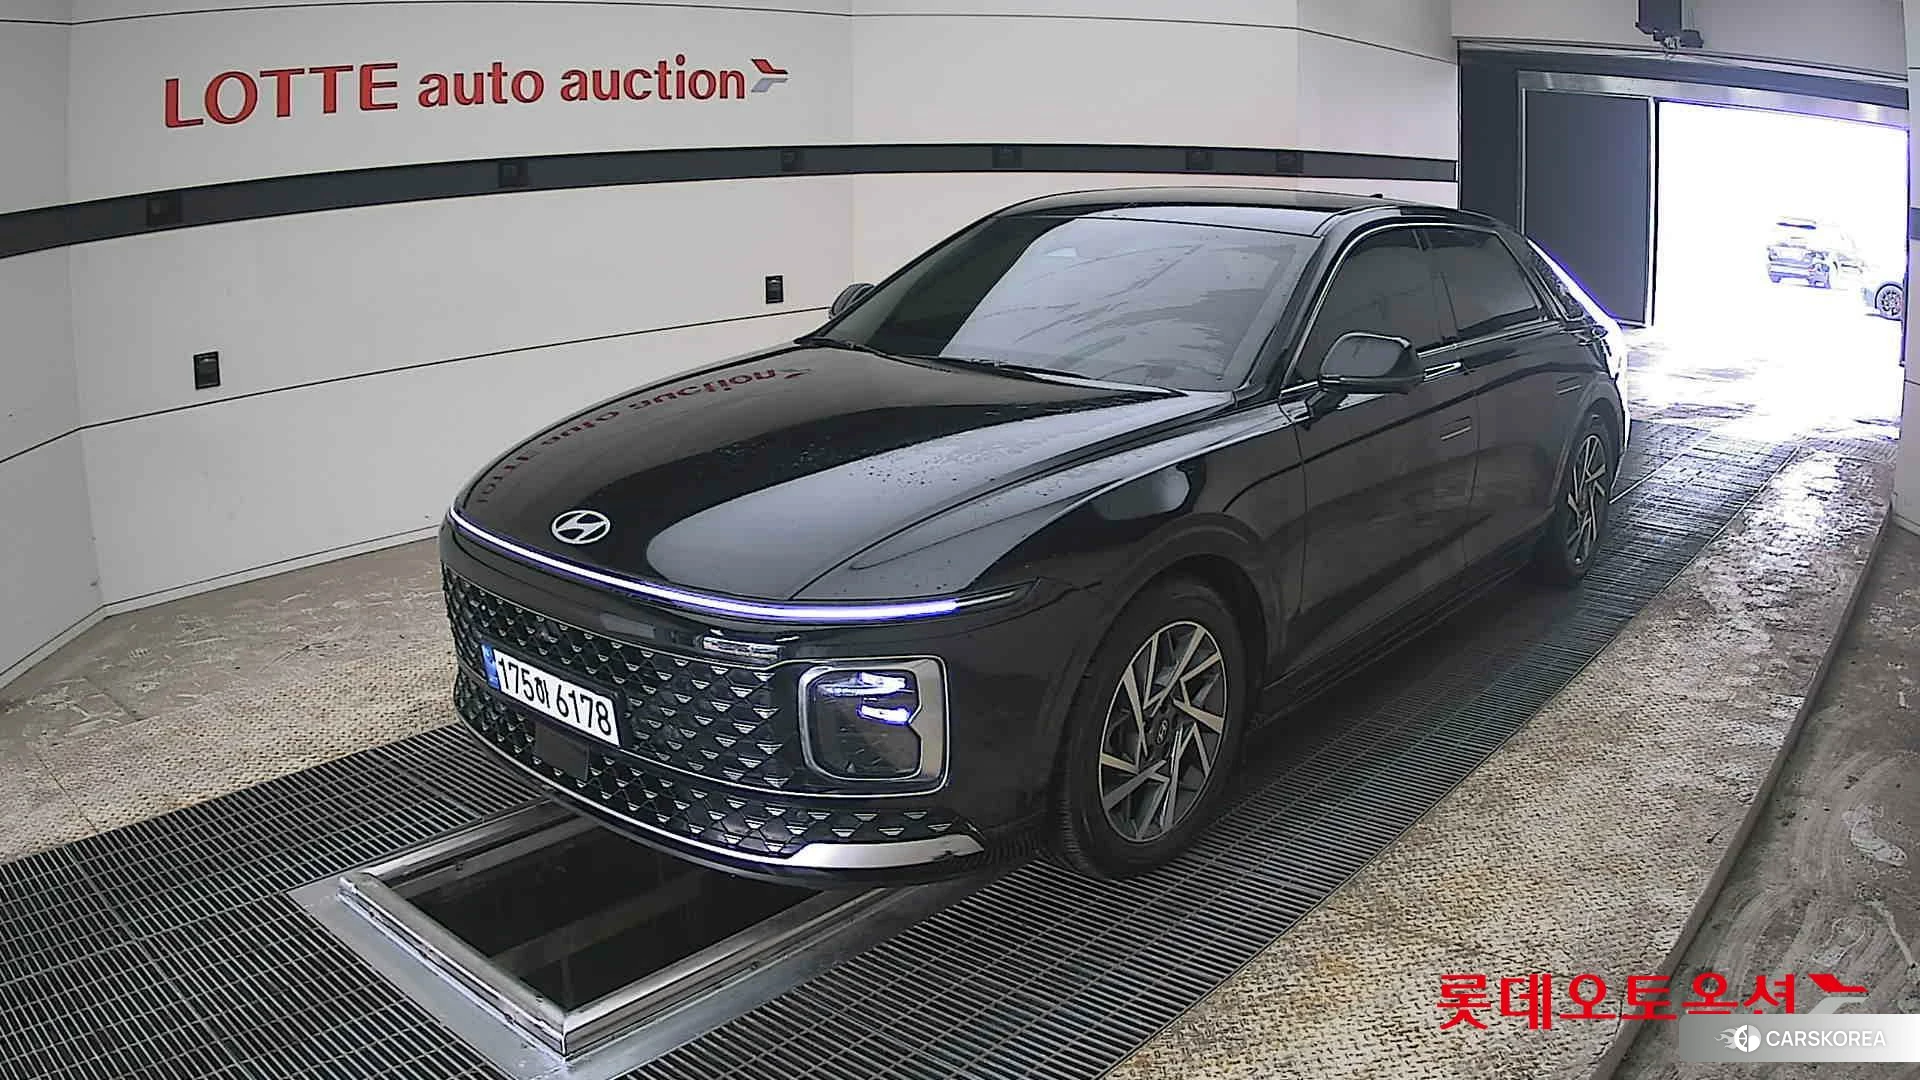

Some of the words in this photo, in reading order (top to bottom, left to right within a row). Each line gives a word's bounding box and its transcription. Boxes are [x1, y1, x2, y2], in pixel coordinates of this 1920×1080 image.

[165, 62, 399, 128] LOTTE
[417, 61, 545, 108] auto
[560, 54, 746, 101] auction
[556, 684, 612, 736] 6178
